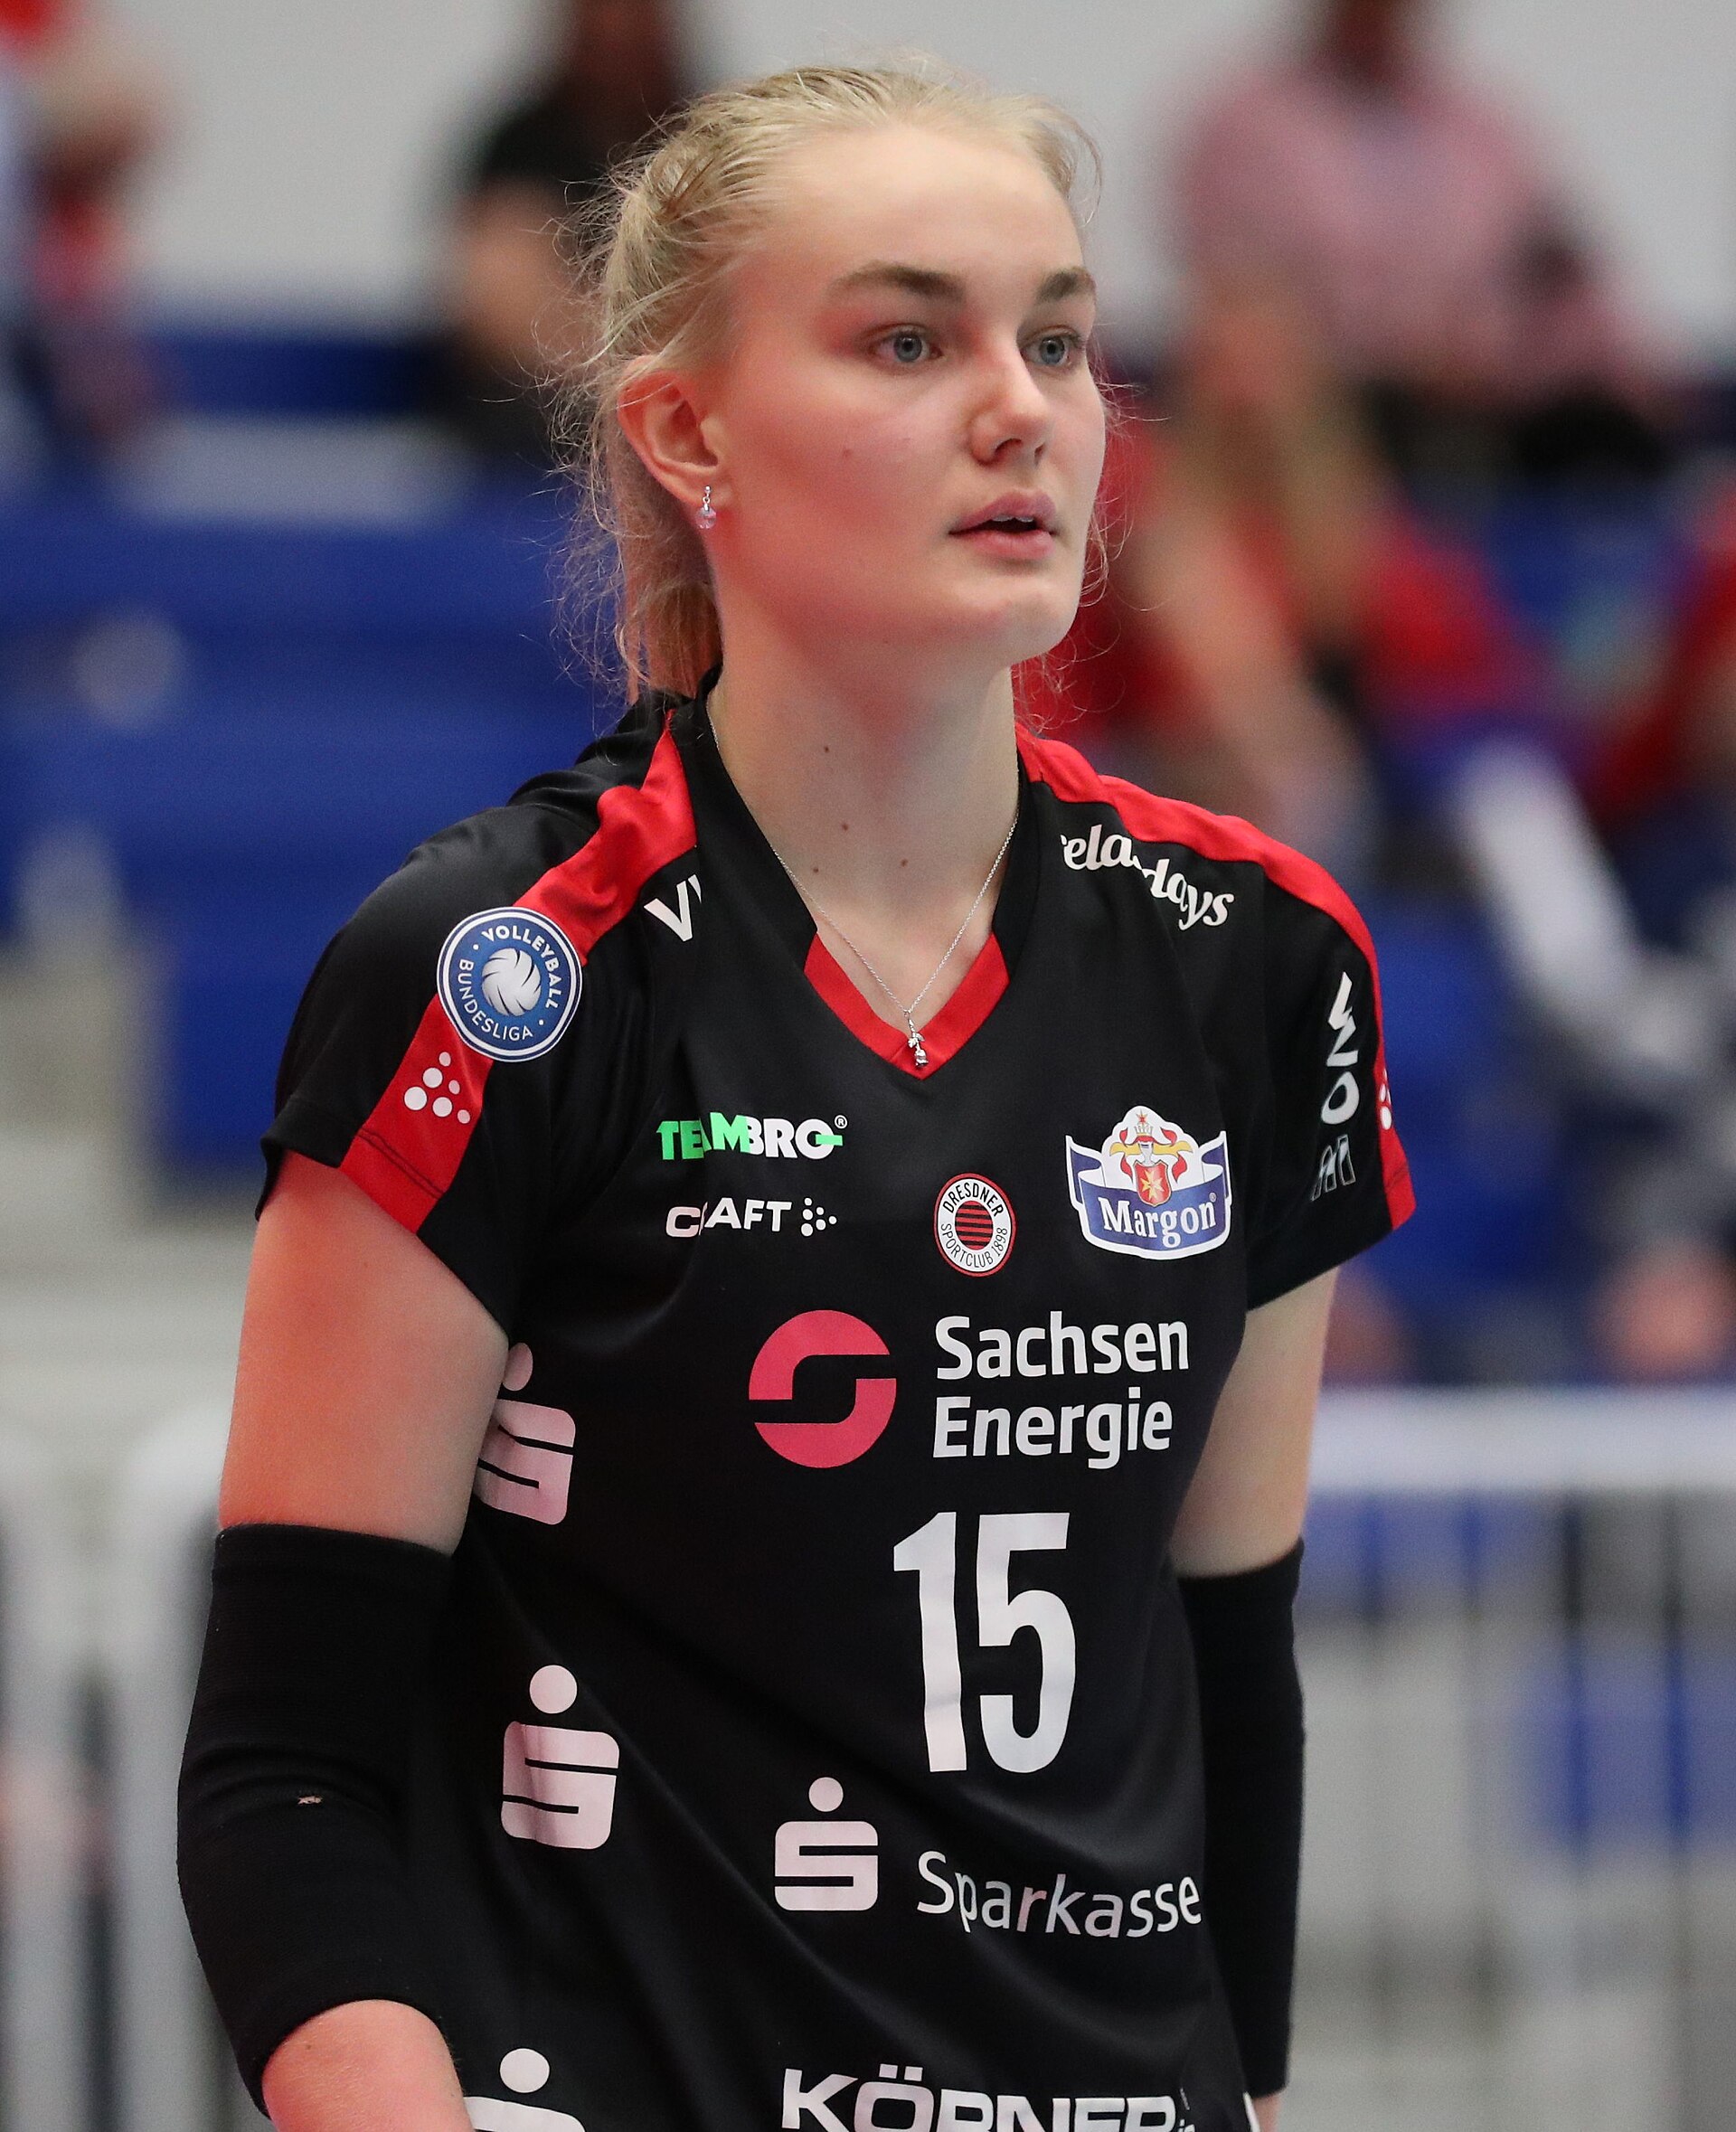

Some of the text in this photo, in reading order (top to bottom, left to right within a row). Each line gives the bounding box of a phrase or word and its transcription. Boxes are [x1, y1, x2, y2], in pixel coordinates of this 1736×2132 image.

[458, 958, 533, 1042] BUNDESLIGA
[481, 925, 562, 1010] VOLLEYBALL
[665, 1197, 792, 1238] CAFT
[942, 1182, 1005, 1217] DRESDNER
[1098, 1196, 1217, 1248] Margon
[940, 1223, 1008, 1269] SPORTCLUB 1898
[935, 1311, 1189, 1380] Sachsen
[933, 1386, 1173, 1469] Energie
[893, 1512, 1076, 1773] 15
[916, 1850, 1202, 1939] Sparkasse
